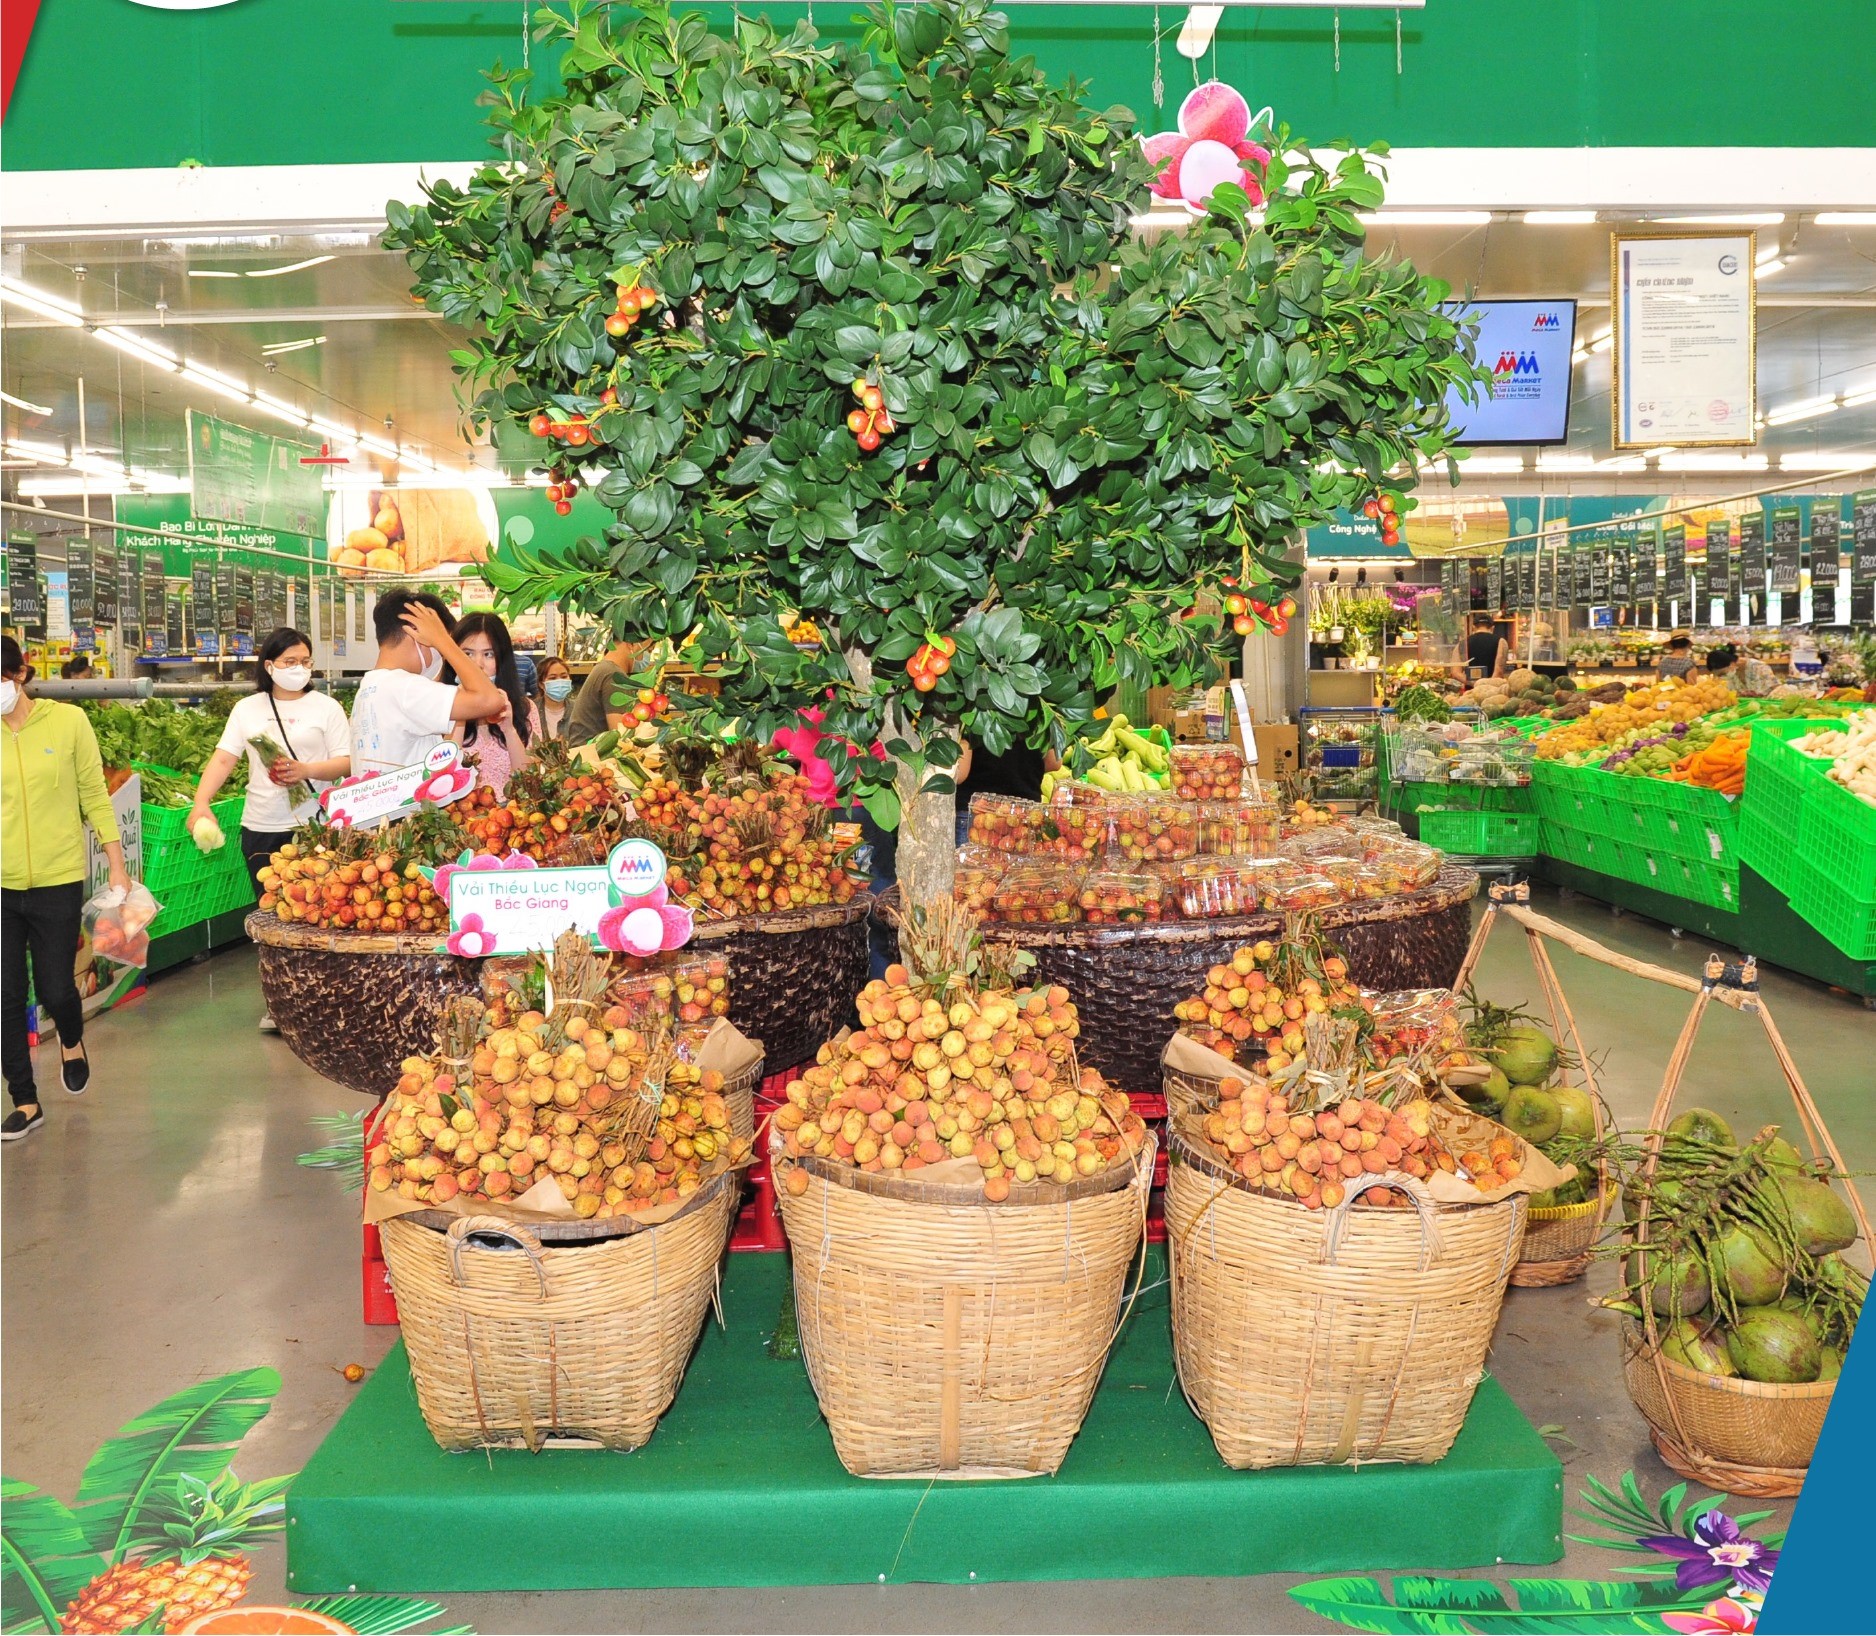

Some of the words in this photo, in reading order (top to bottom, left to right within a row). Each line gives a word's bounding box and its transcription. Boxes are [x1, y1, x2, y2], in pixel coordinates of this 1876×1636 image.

[1329, 524, 1352, 536] Công
[372, 784, 399, 798] Giang
[458, 881, 484, 896] Vải
[533, 880, 559, 897] Lục
[565, 879, 607, 896] Ngạn
[494, 896, 521, 910] Bắc
[525, 897, 569, 911] Giang
